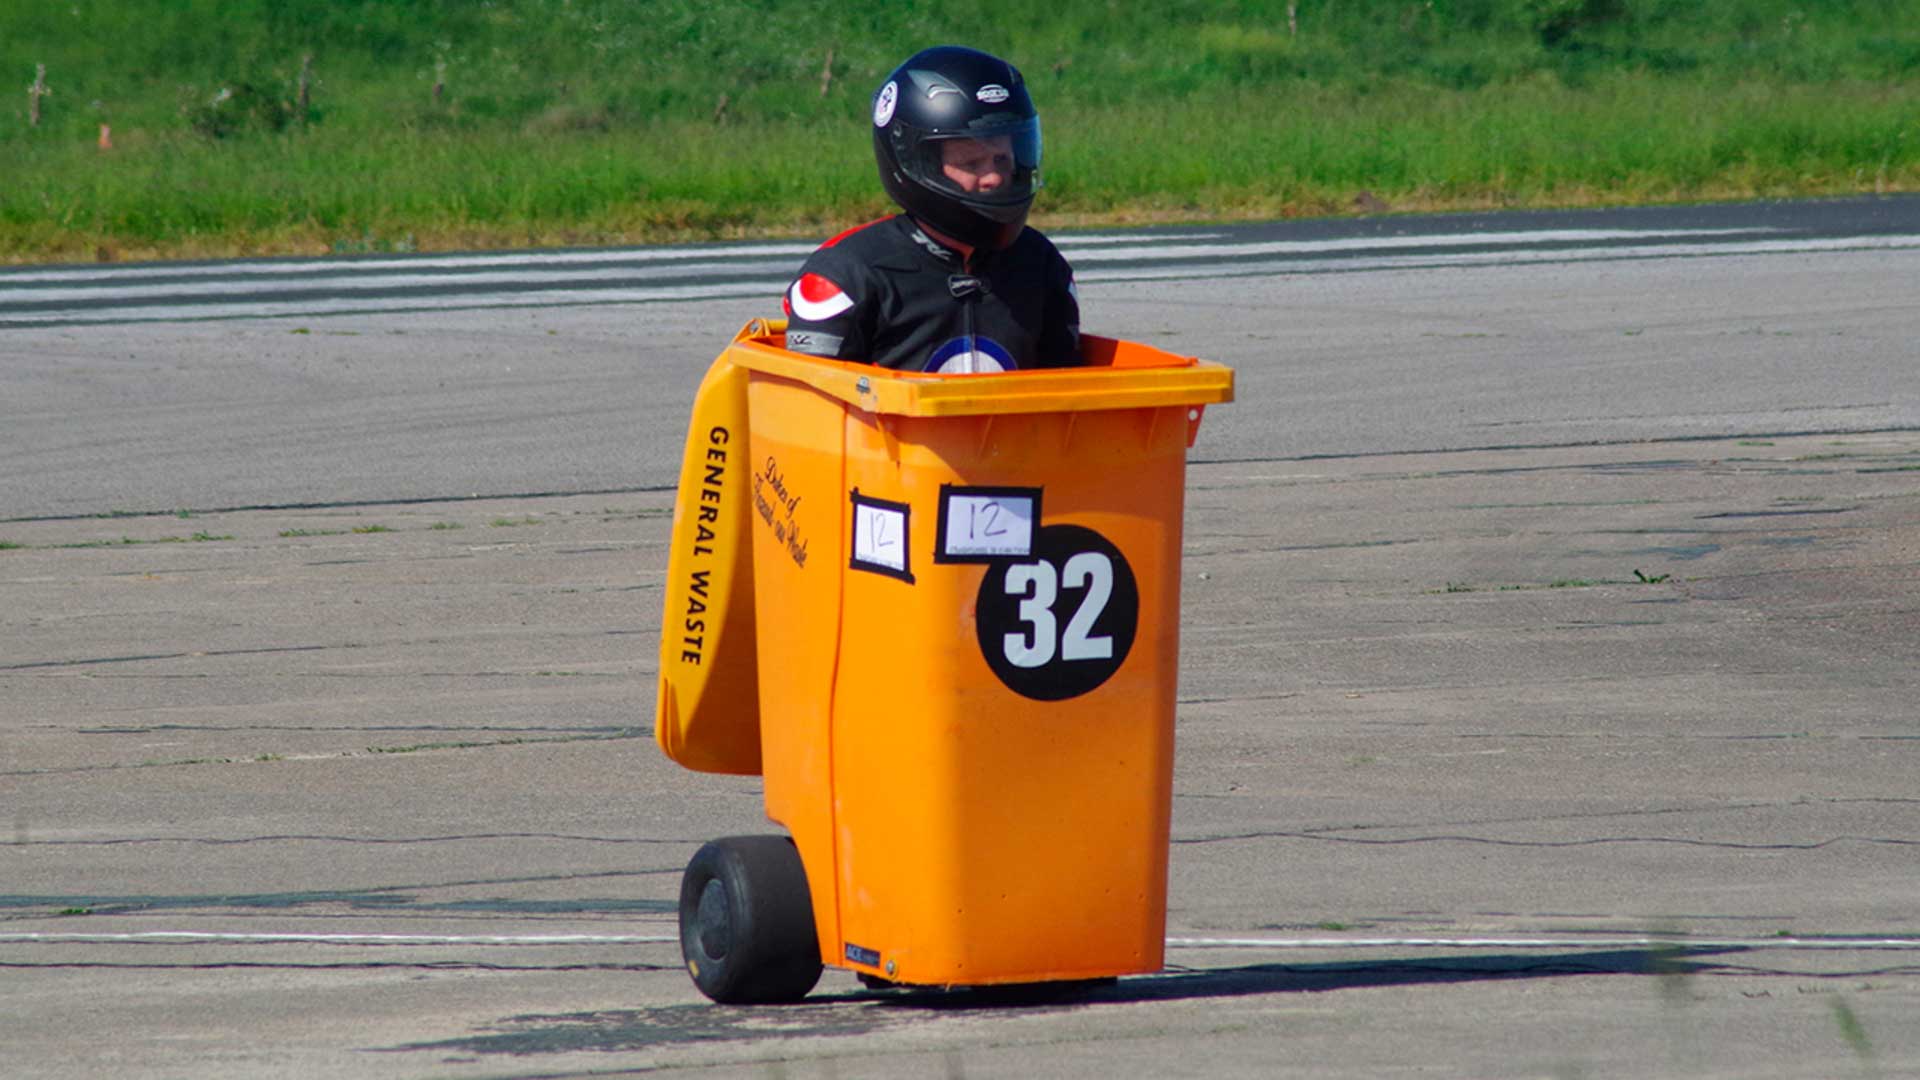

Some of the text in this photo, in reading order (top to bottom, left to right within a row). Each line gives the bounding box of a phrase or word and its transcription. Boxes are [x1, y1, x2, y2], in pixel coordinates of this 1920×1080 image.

[681, 426, 729, 665] GENERAL WASTE
[870, 512, 895, 553] 12
[970, 501, 1007, 539] 12
[1003, 551, 1113, 669] 32
